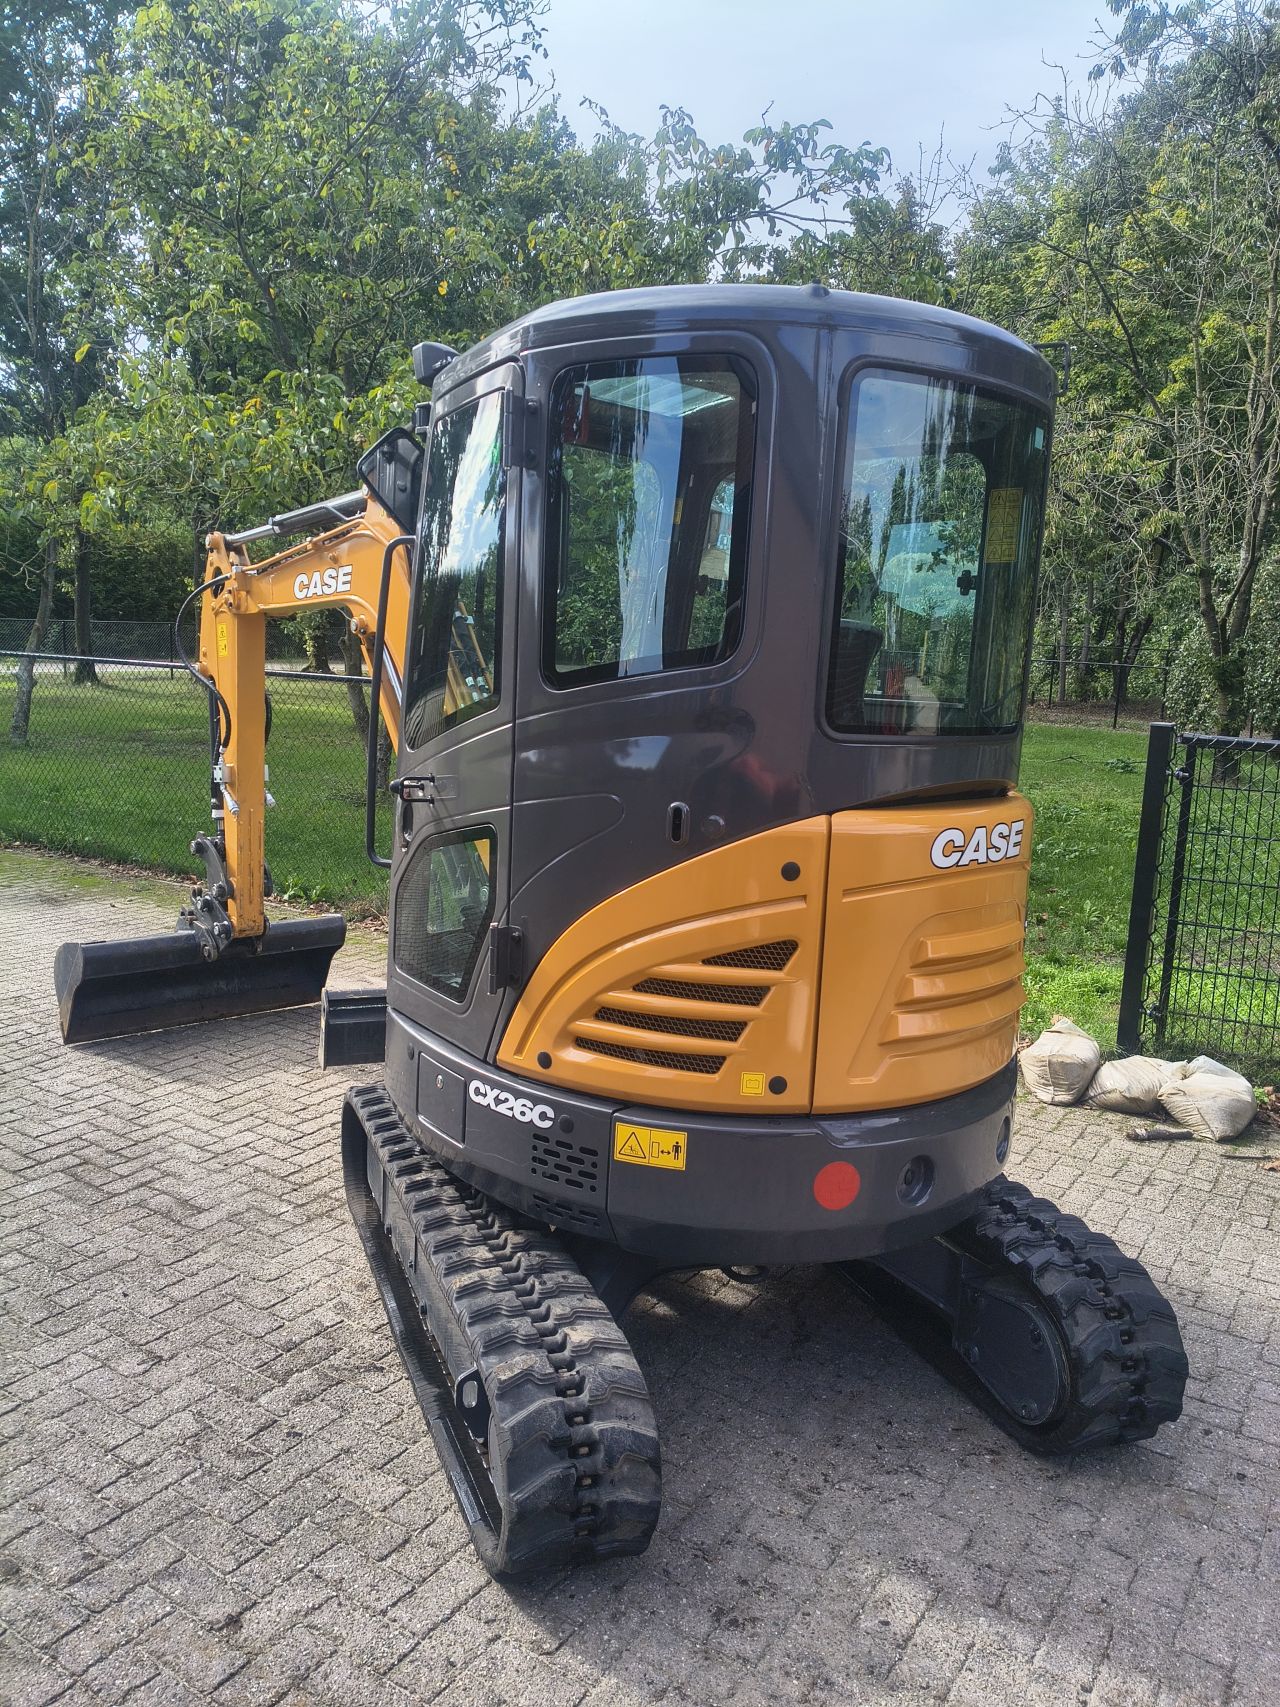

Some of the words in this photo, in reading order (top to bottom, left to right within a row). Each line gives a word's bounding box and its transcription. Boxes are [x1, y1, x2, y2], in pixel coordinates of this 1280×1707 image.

[293, 564, 353, 600] CASE
[930, 819, 1024, 869] CASE
[468, 1079, 555, 1129] CX26C
